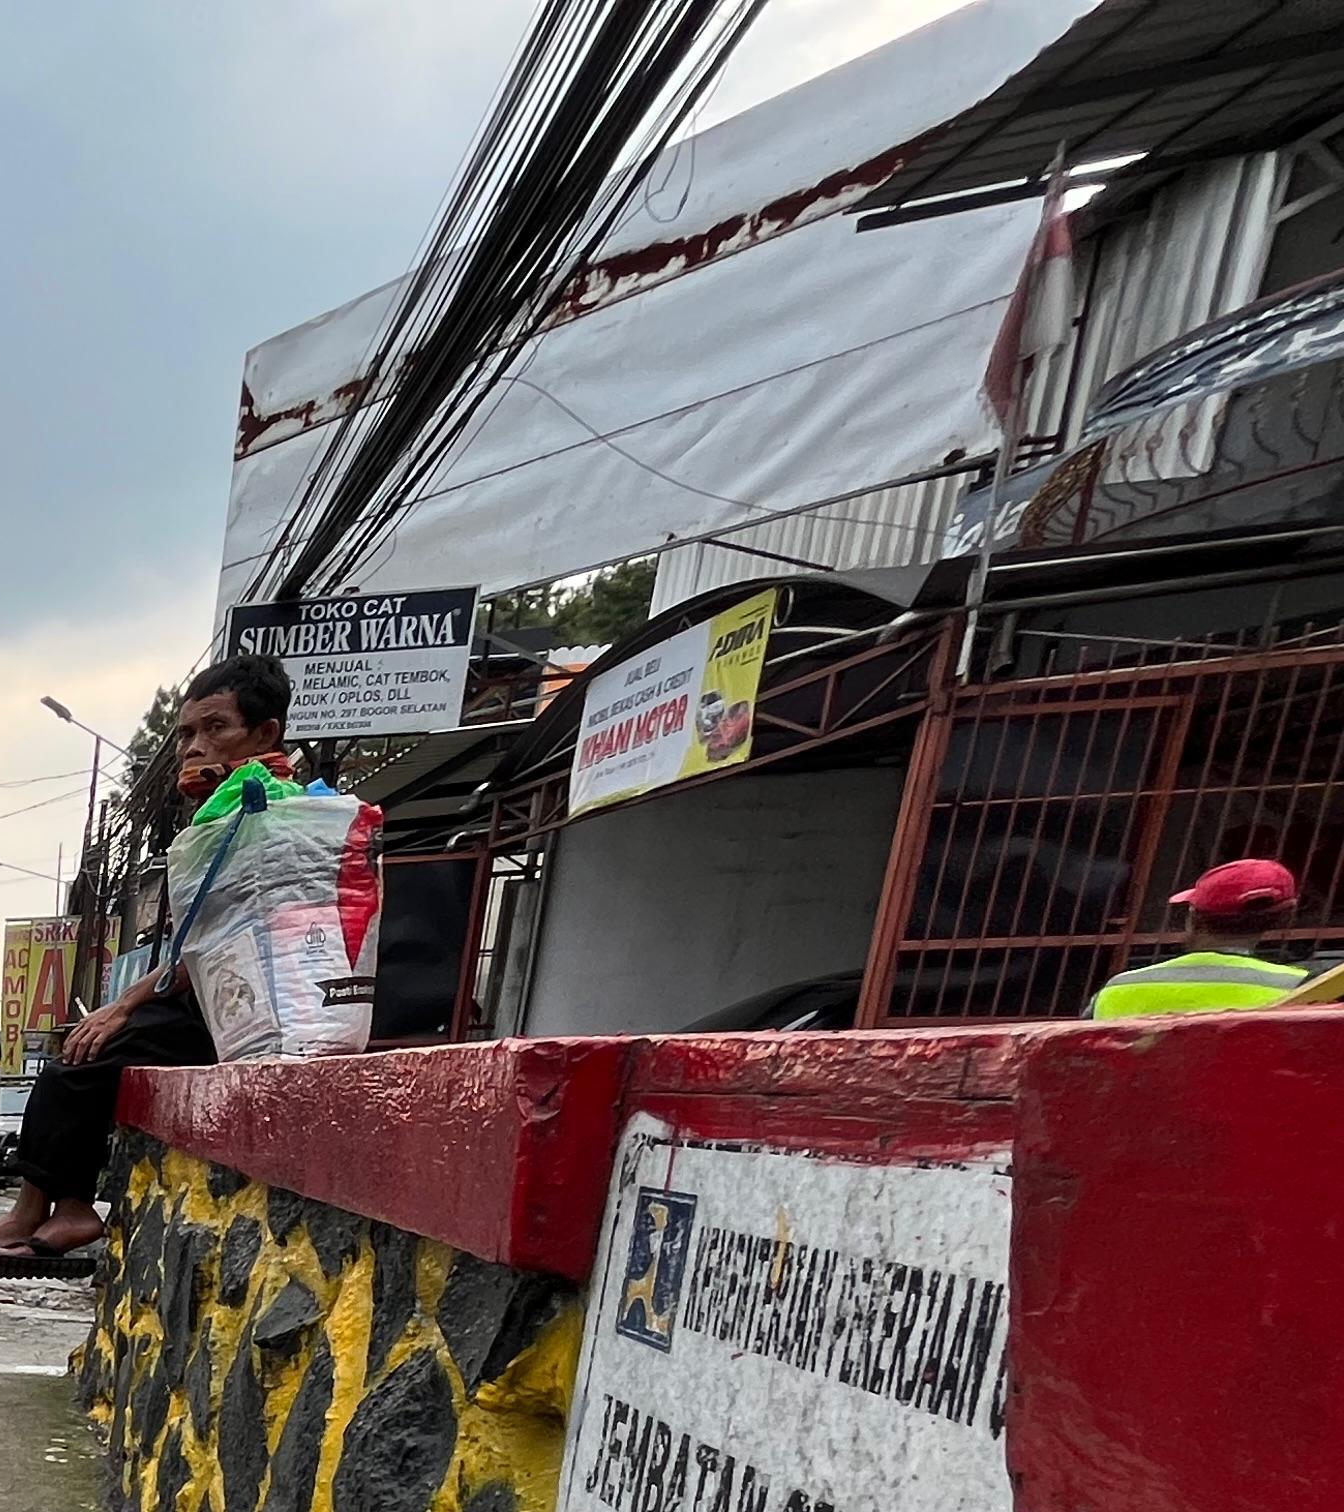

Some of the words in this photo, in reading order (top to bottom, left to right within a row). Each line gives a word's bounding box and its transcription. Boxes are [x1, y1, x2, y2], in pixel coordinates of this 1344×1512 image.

[298, 601, 358, 621] TOKO
[363, 597, 407, 616] CAT
[238, 620, 352, 657] SUMBER
[360, 611, 456, 651] WARNA
[707, 616, 765, 663] ADIRA
[304, 659, 373, 675] MENJUAL
[302, 678, 362, 692] MELAMIC,
[366, 673, 390, 687] CAT
[395, 669, 451, 685] TEMBOK,
[293, 693, 328, 707] ADUK
[338, 690, 384, 705] OPLOS,
[387, 688, 412, 701] DLL
[360, 705, 398, 717] BOGOR
[400, 702, 447, 715] SELATAN
[632, 693, 689, 751] MOTOR
